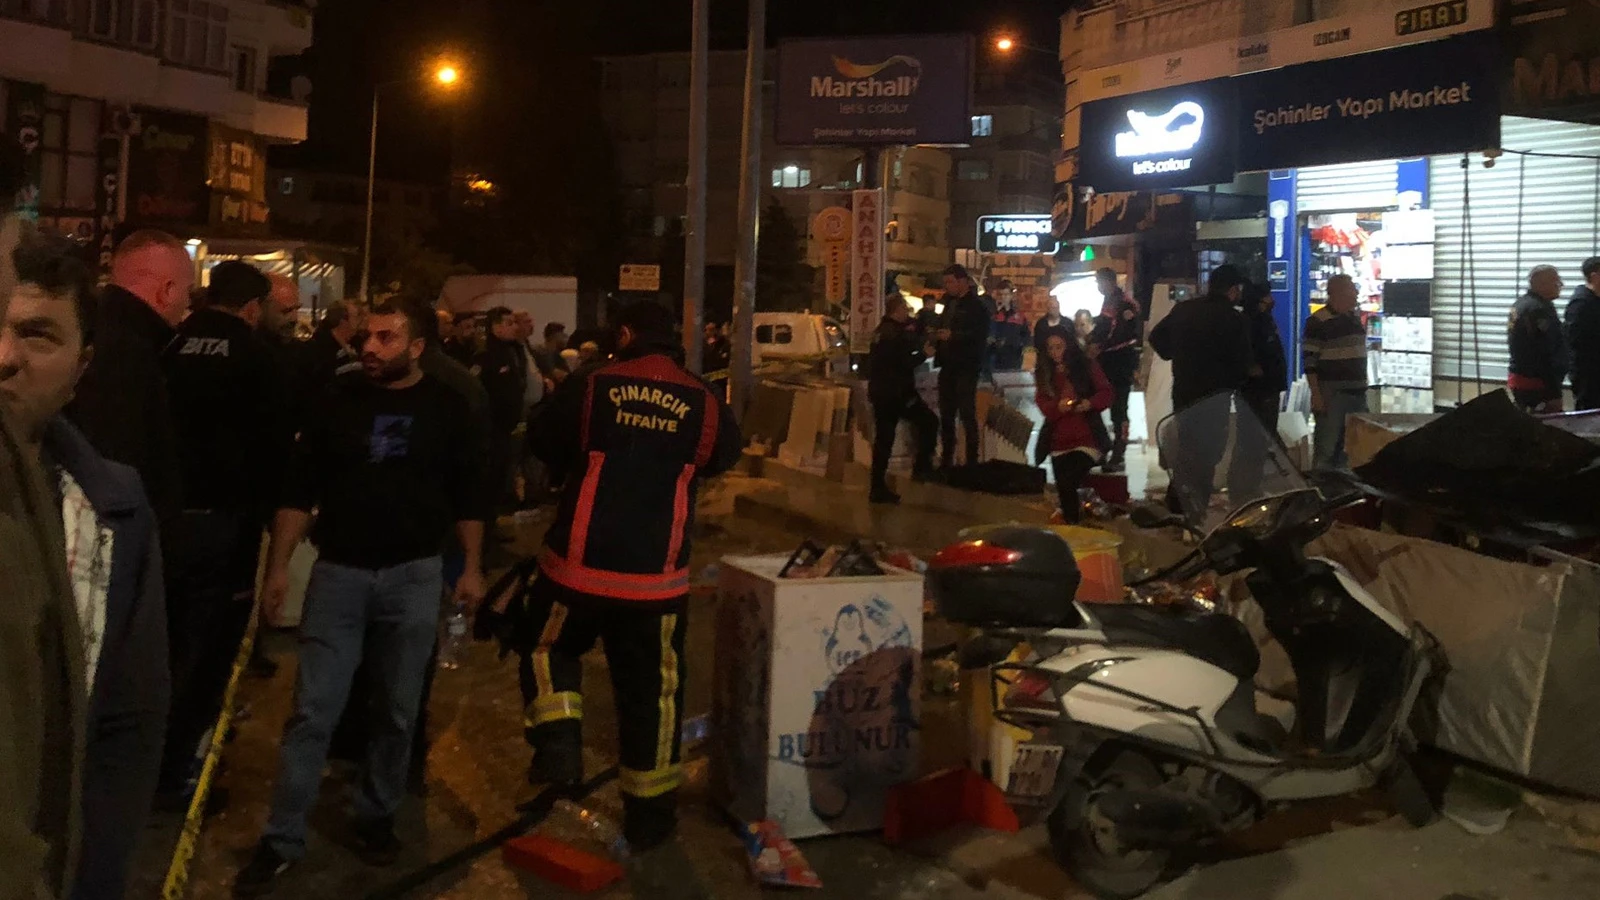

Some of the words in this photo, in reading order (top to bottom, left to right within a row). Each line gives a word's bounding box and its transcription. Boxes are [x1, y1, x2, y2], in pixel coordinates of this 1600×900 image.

[1397, 3, 1466, 34] FIRAT
[810, 75, 911, 97] Marshall
[866, 102, 909, 115] colour
[1253, 102, 1332, 134] Şahinler
[1336, 97, 1385, 119] Yapı
[1388, 81, 1472, 110] Market
[857, 194, 875, 330] ANAHTARCI
[609, 384, 691, 420] ÇINARCIK
[616, 409, 678, 433] İTFAİYE
[812, 686, 883, 717] BUZ
